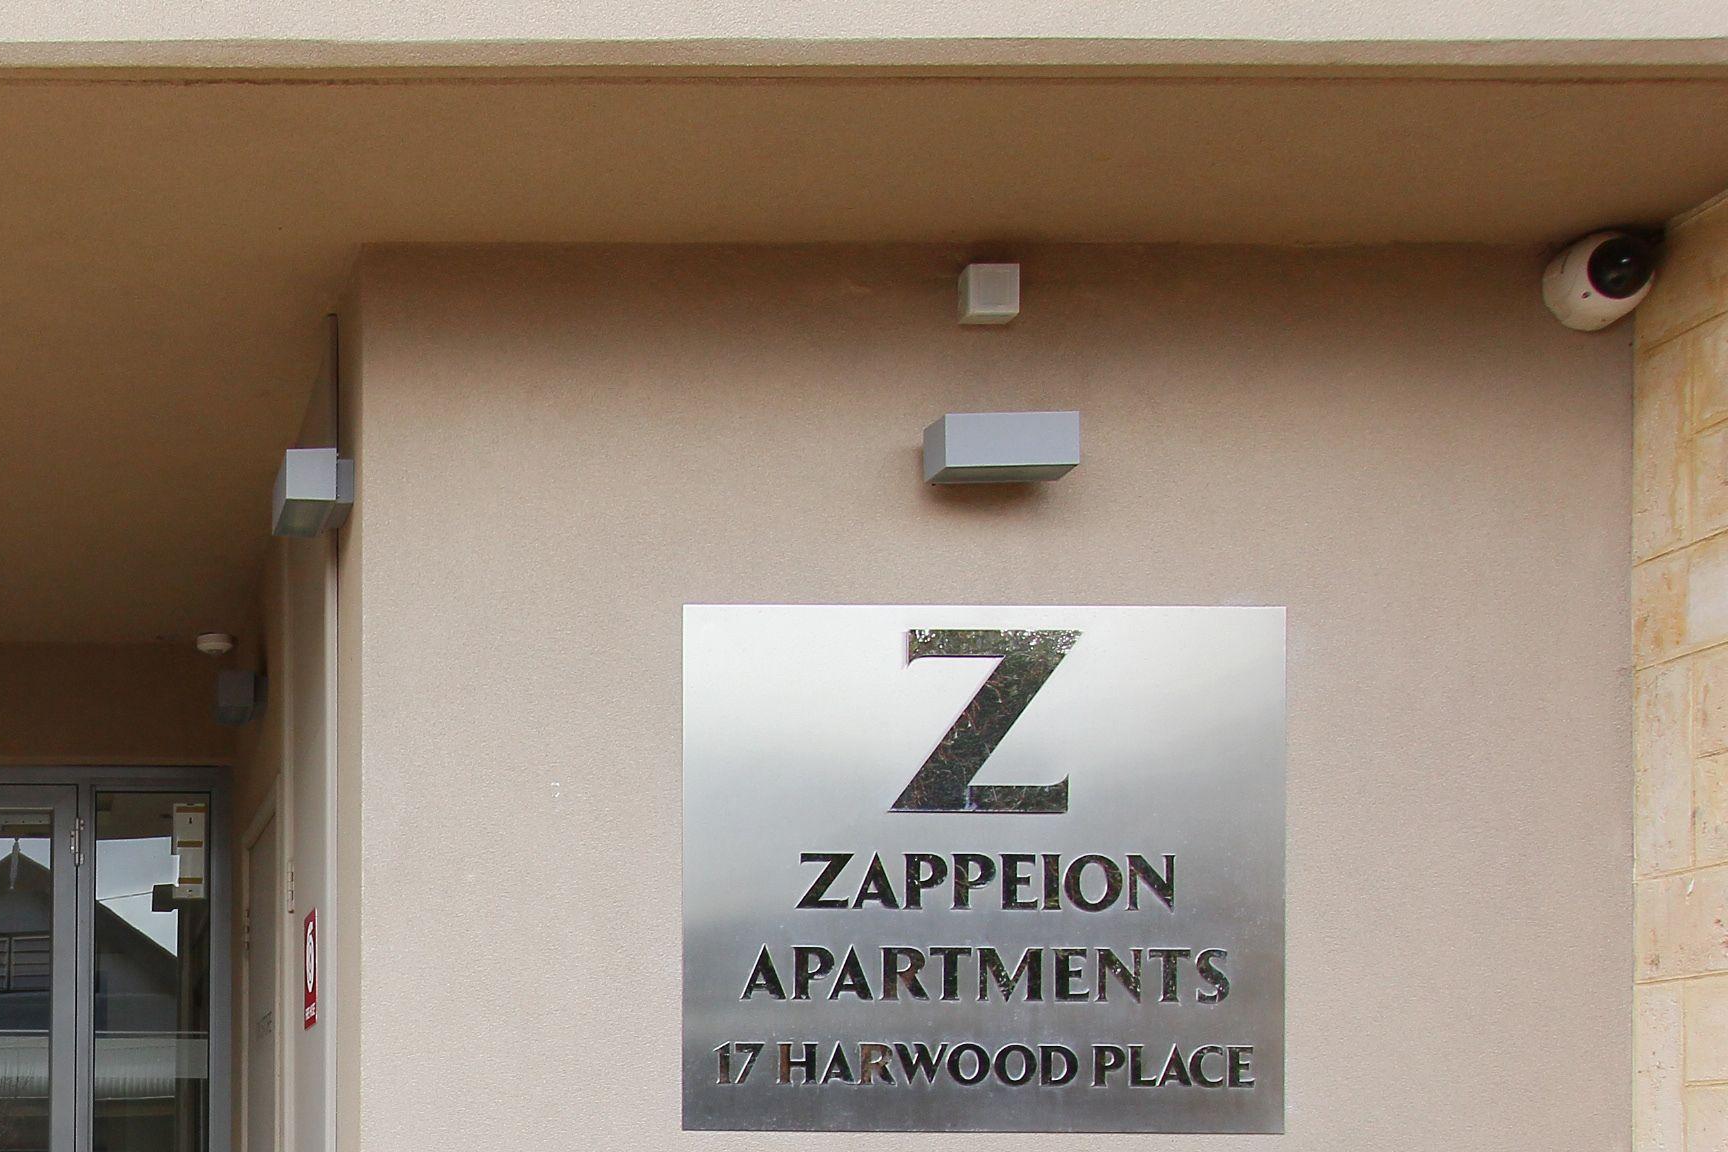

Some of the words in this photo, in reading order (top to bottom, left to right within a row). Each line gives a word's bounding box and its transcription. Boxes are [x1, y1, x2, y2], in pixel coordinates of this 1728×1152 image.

[887, 628, 1083, 814] Z
[794, 851, 1177, 913] ZAPPEION
[739, 943, 1231, 1005] APARTMENTS
[713, 1041, 765, 1087] 17
[776, 1041, 1079, 1088] HARWOOD
[1091, 1043, 1257, 1089] PLACE
